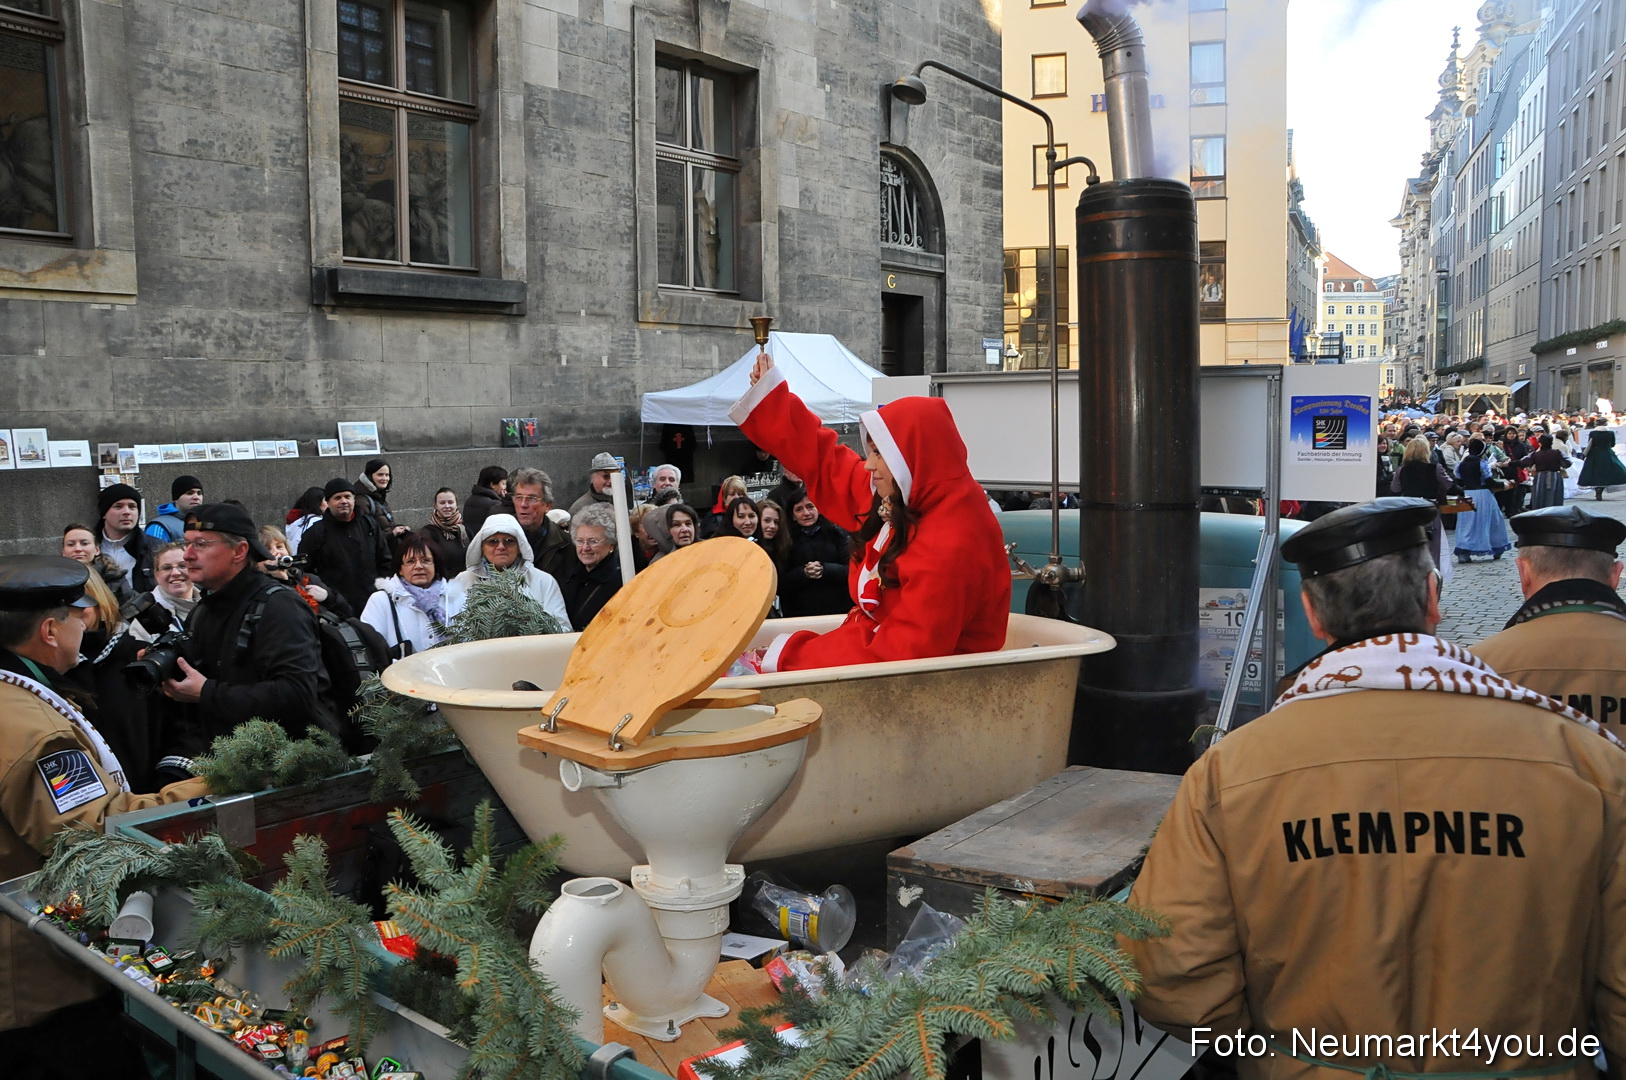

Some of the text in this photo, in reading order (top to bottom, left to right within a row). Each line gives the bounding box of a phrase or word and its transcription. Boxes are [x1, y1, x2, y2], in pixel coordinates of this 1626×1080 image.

[887, 274, 896, 288] G
[43, 759, 58, 771] SHK
[1282, 811, 1526, 862] KLEMPNER
